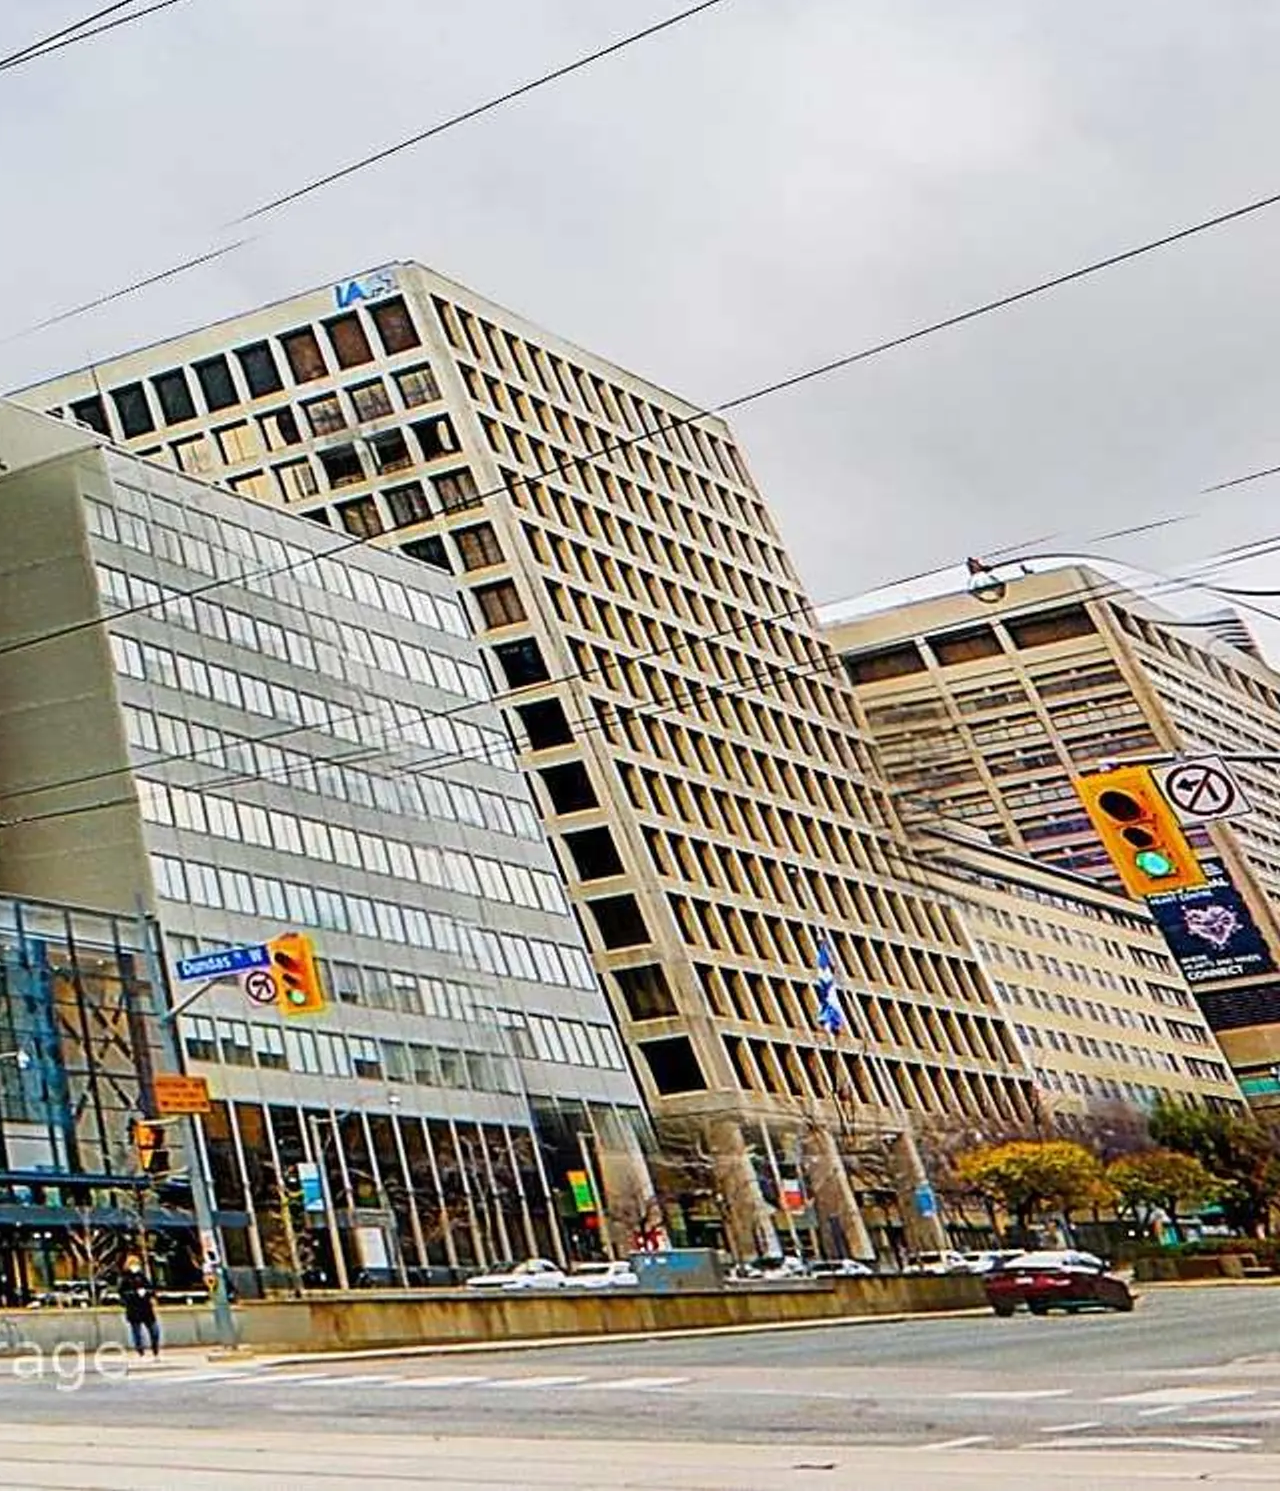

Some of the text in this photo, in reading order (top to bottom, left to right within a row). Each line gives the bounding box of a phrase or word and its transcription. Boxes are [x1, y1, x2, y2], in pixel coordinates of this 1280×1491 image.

[181, 955, 232, 976] Dundas
[247, 949, 263, 963] W
[1187, 965, 1243, 980] CONNECT
